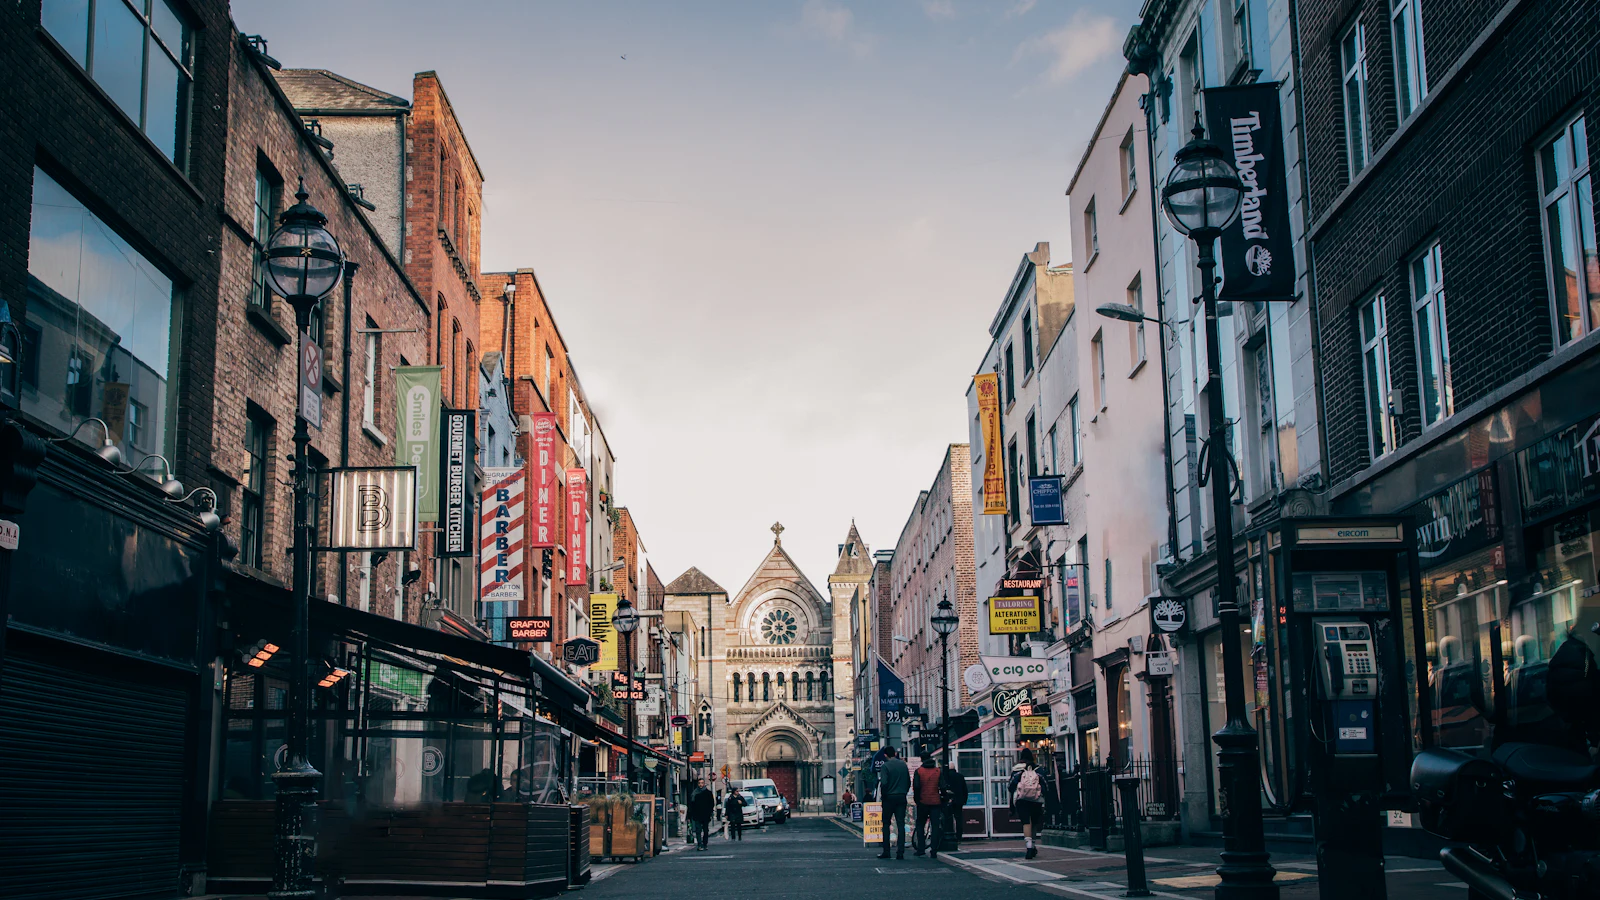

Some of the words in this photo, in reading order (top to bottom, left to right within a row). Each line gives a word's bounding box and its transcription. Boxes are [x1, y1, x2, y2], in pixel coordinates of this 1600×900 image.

[1230, 110, 1269, 240] Timberland
[412, 393, 426, 436] Smiles
[451, 414, 464, 464] GOURMET
[450, 465, 462, 504] BURGER
[538, 450, 548, 542] DINER
[358, 485, 392, 533] B
[450, 508, 462, 552] KITCHEN
[495, 488, 510, 583] BARBER
[572, 502, 580, 580] DINER
[1004, 580, 1042, 588] RESTAURANT
[510, 620, 550, 628] GRAFTON
[592, 603, 612, 643] GOTHAM
[566, 644, 596, 661] EAT
[992, 667, 1000, 675] e
[1003, 665, 1024, 676] cig
[1027, 664, 1044, 673] co
[887, 711, 900, 722] 22
[994, 689, 1031, 716] Cave
